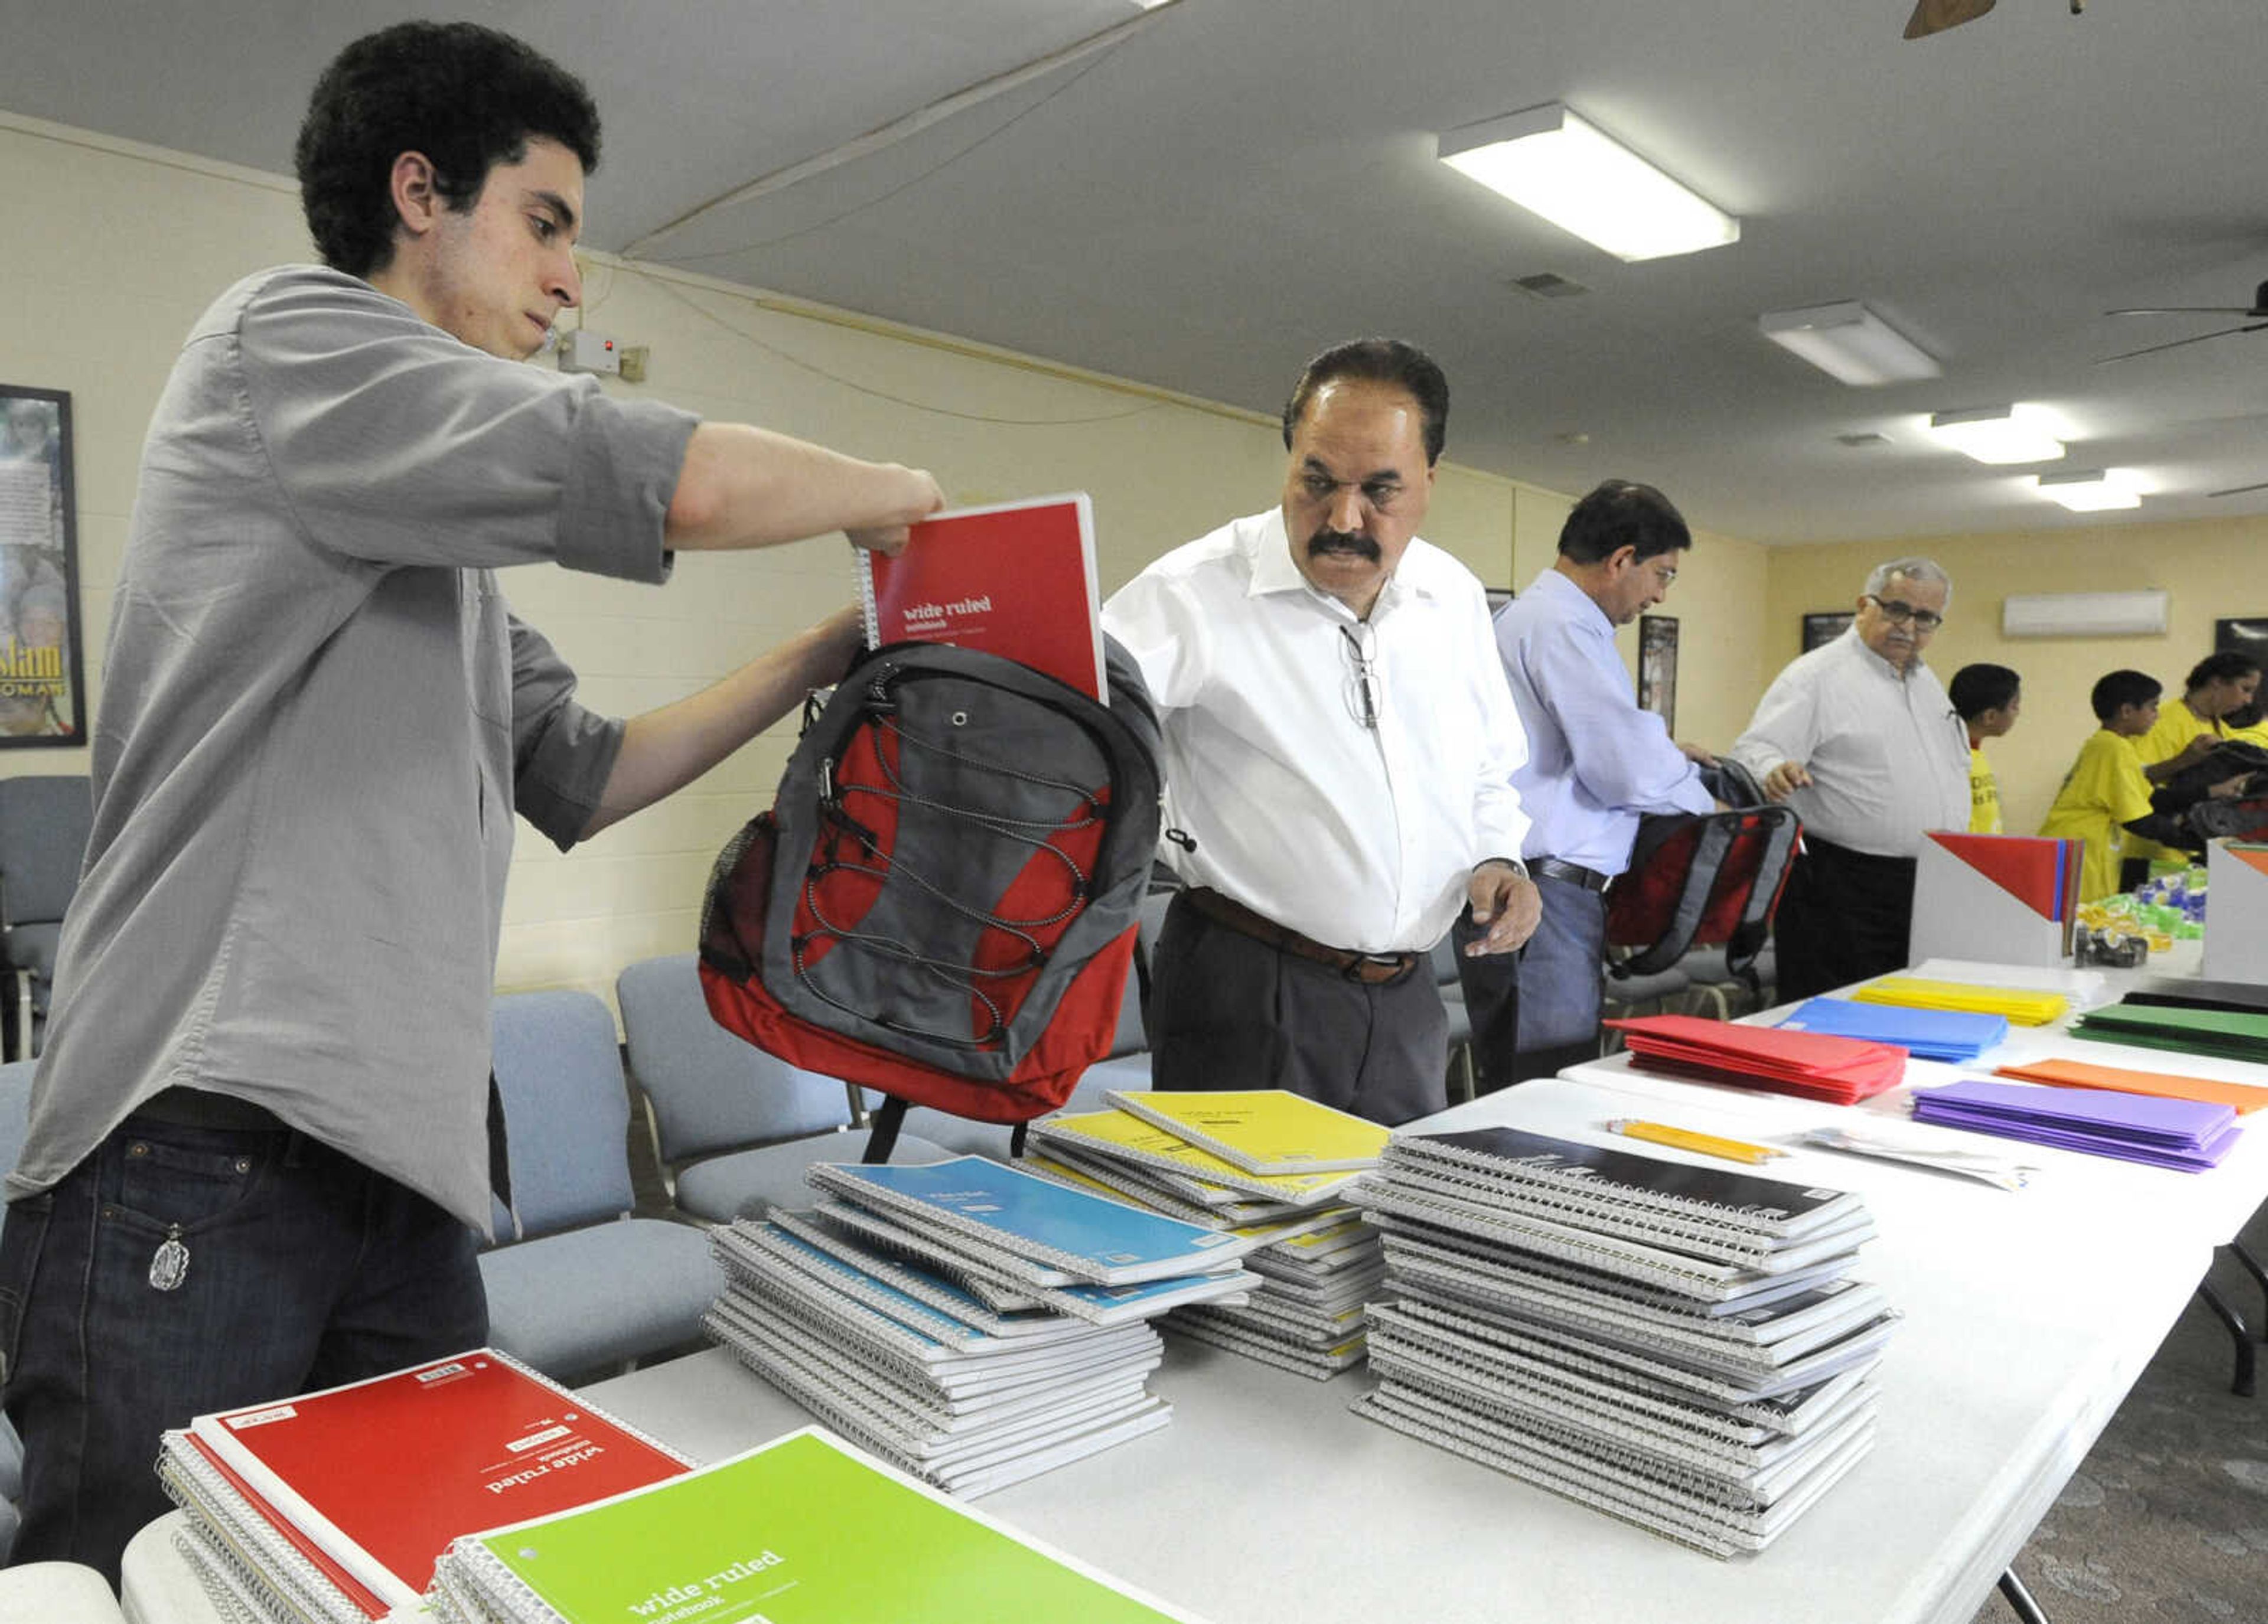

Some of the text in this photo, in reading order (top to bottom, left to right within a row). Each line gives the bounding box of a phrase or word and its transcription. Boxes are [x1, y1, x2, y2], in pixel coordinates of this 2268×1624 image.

[903, 595, 992, 621] wide ruled
[552, 1446, 605, 1469] wide
[485, 1465, 550, 1494] ruled
[628, 1585, 703, 1616] wide
[703, 1550, 786, 1590] ruled
